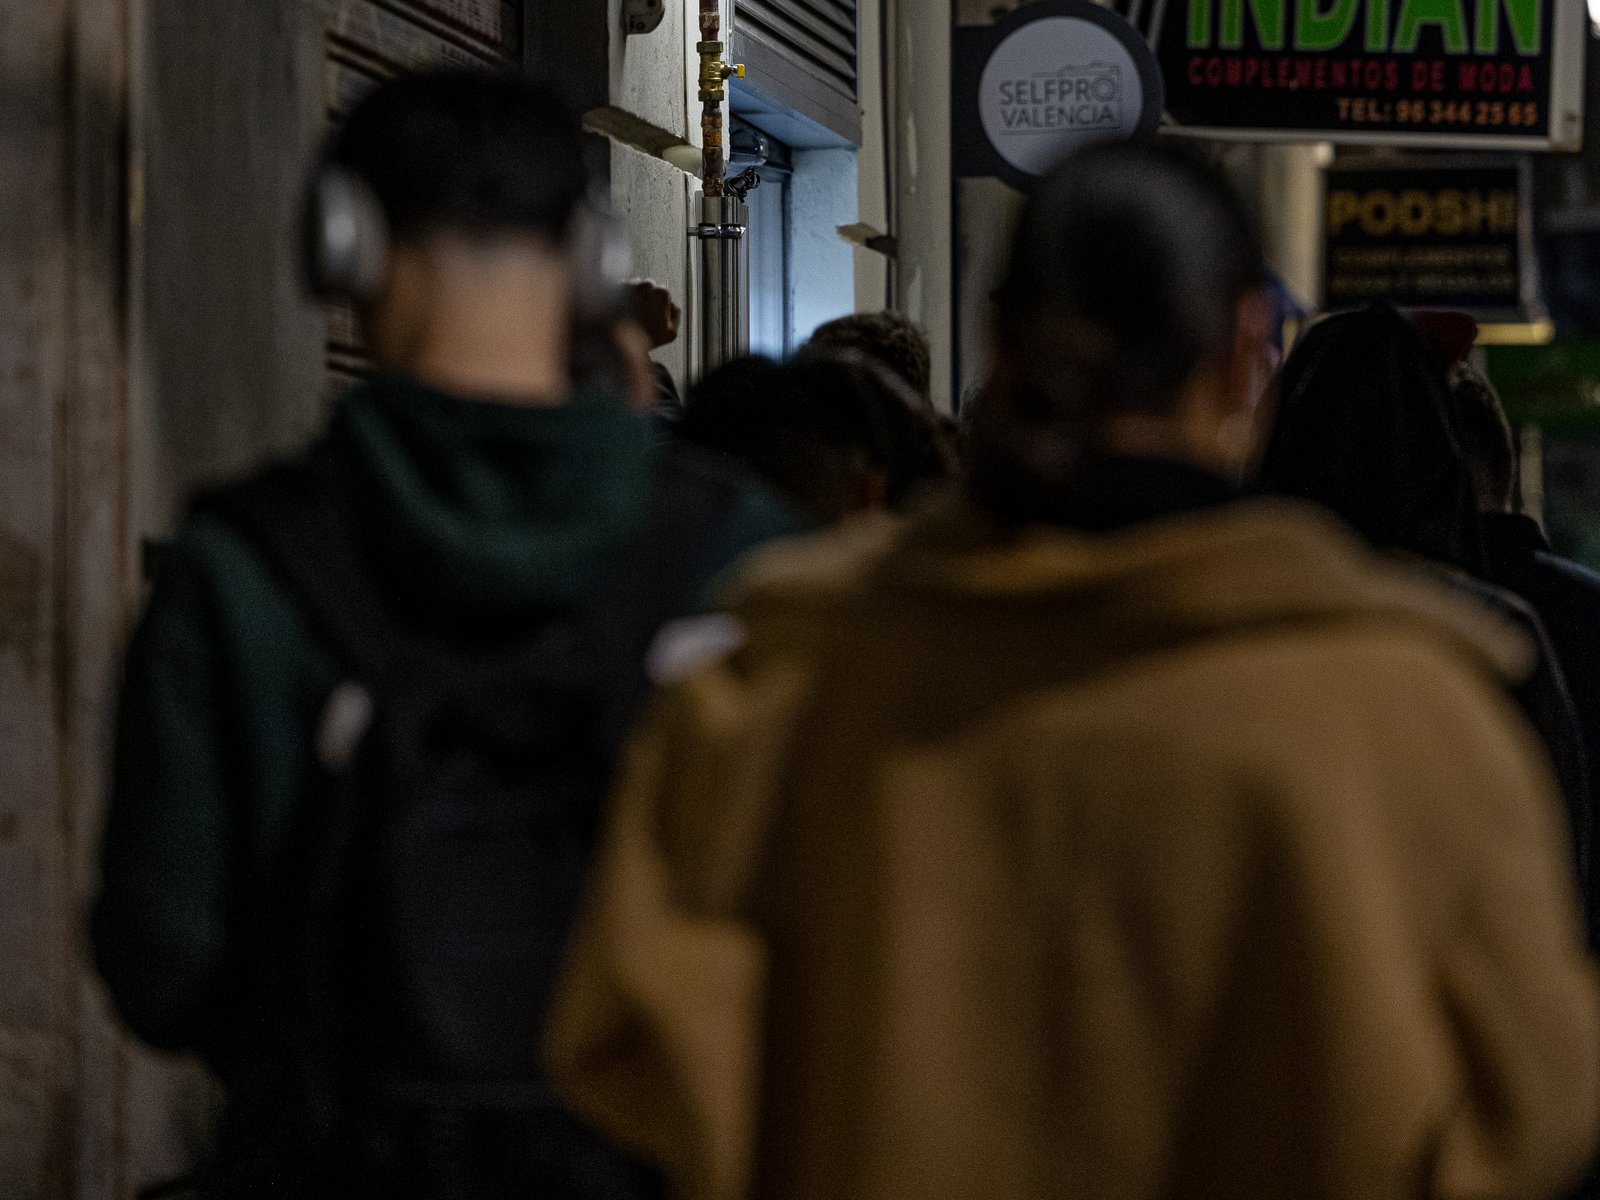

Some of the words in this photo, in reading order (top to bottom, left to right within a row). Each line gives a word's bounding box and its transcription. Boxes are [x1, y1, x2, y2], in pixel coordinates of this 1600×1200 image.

[1187, 56, 1399, 89] COMPLEMENTOS
[1411, 59, 1446, 92] DE
[1459, 63, 1534, 93] MODA
[999, 76, 1116, 106] SELFPRO
[1000, 103, 1117, 129] VALENCIA
[1337, 97, 1392, 123] TEL:
